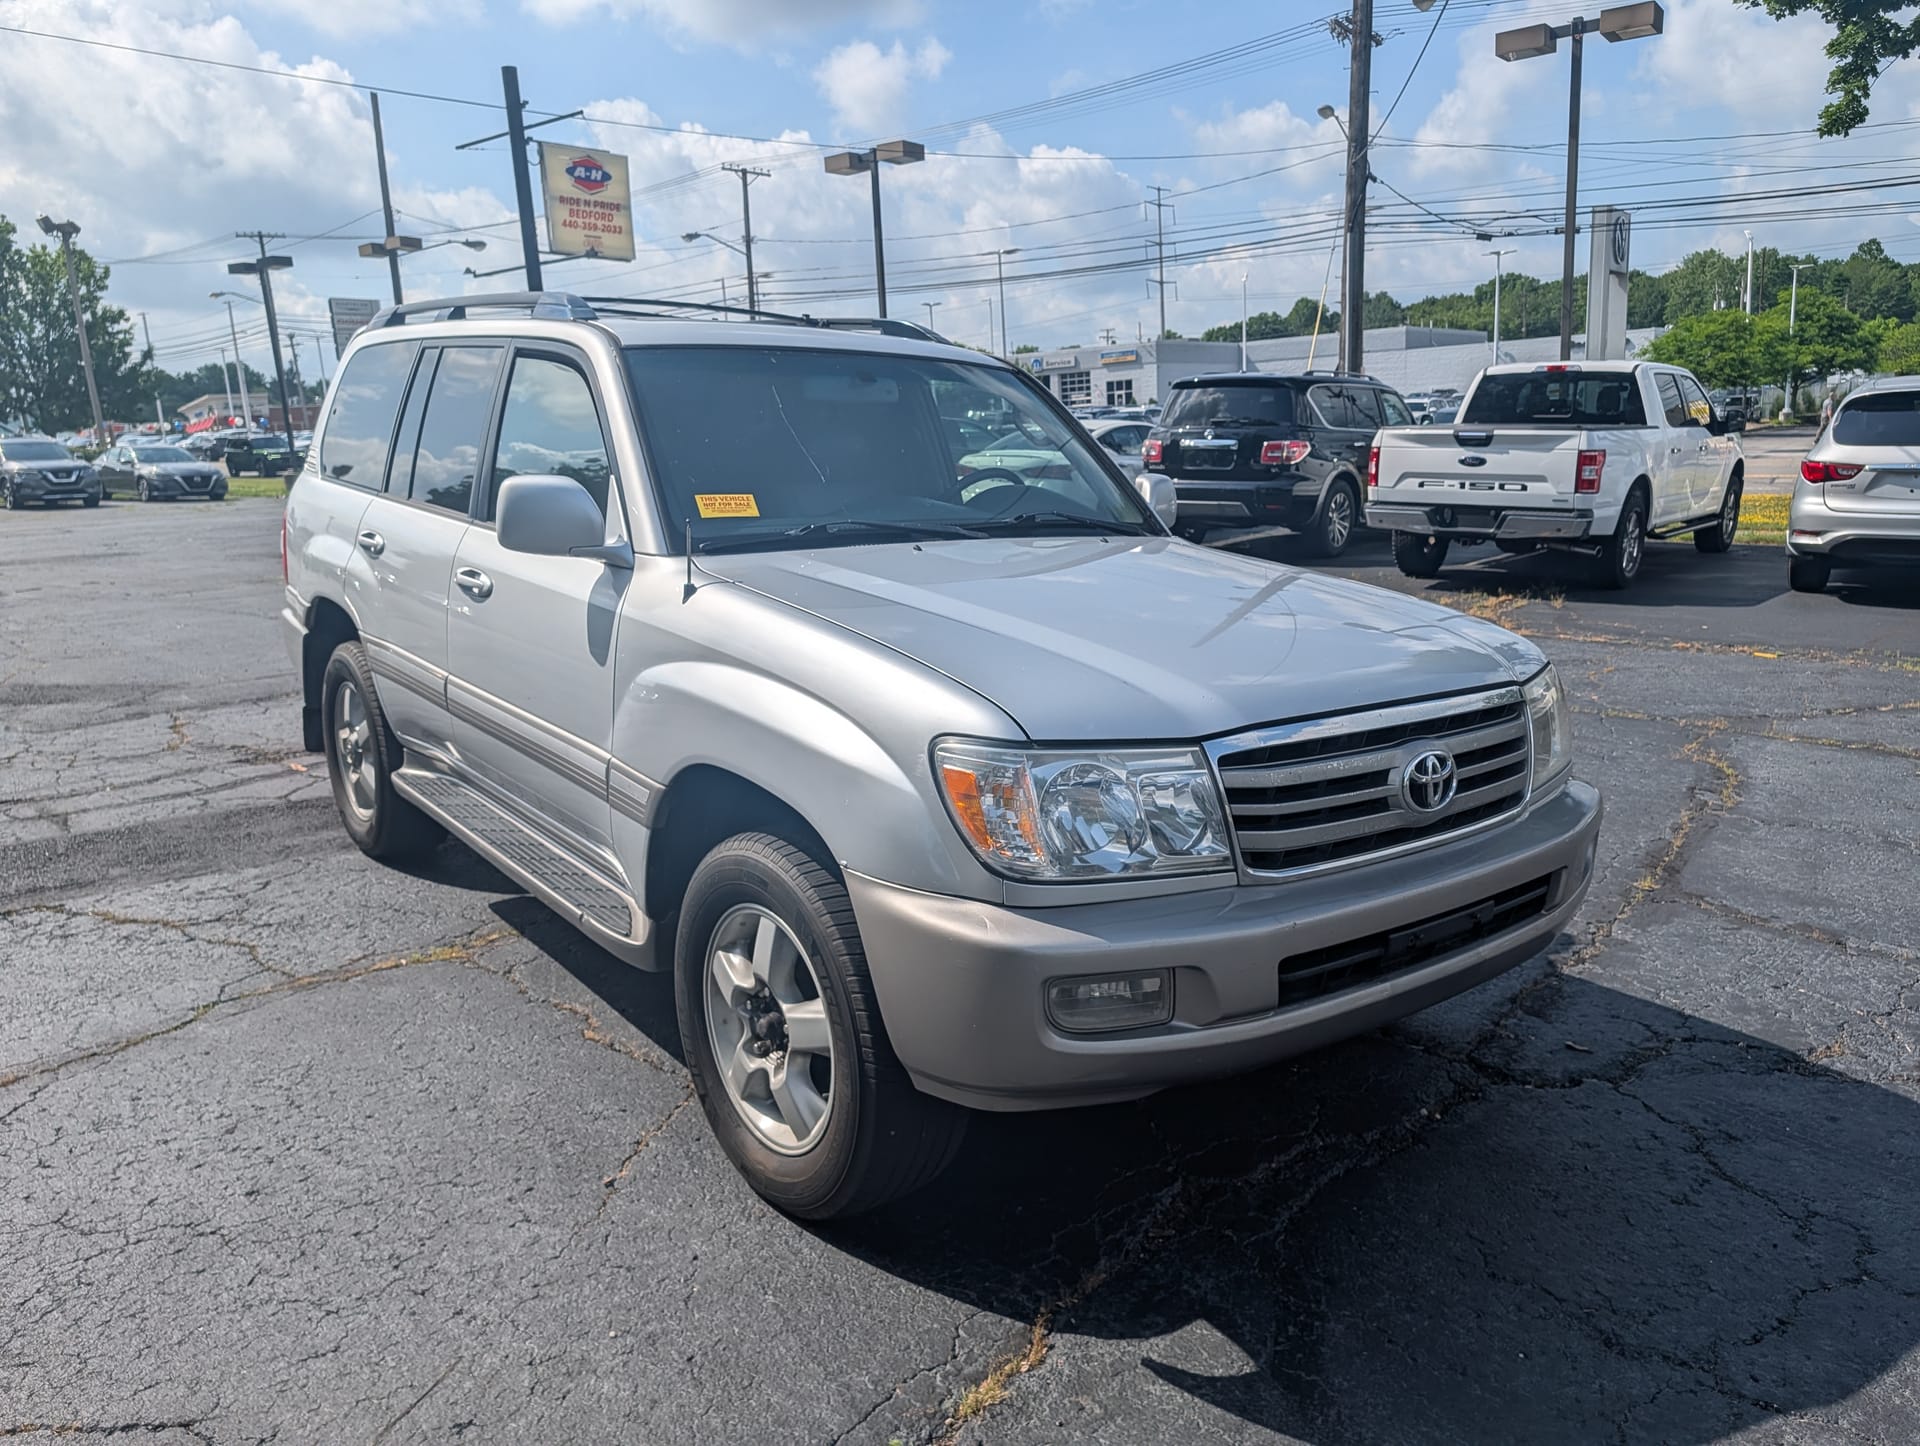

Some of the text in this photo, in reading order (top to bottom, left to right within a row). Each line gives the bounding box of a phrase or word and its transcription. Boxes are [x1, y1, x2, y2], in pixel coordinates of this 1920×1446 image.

[559, 195, 622, 213] RIDE N PRIDE
[569, 208, 614, 223] BEDFORD
[1418, 481, 1528, 492] F-150
